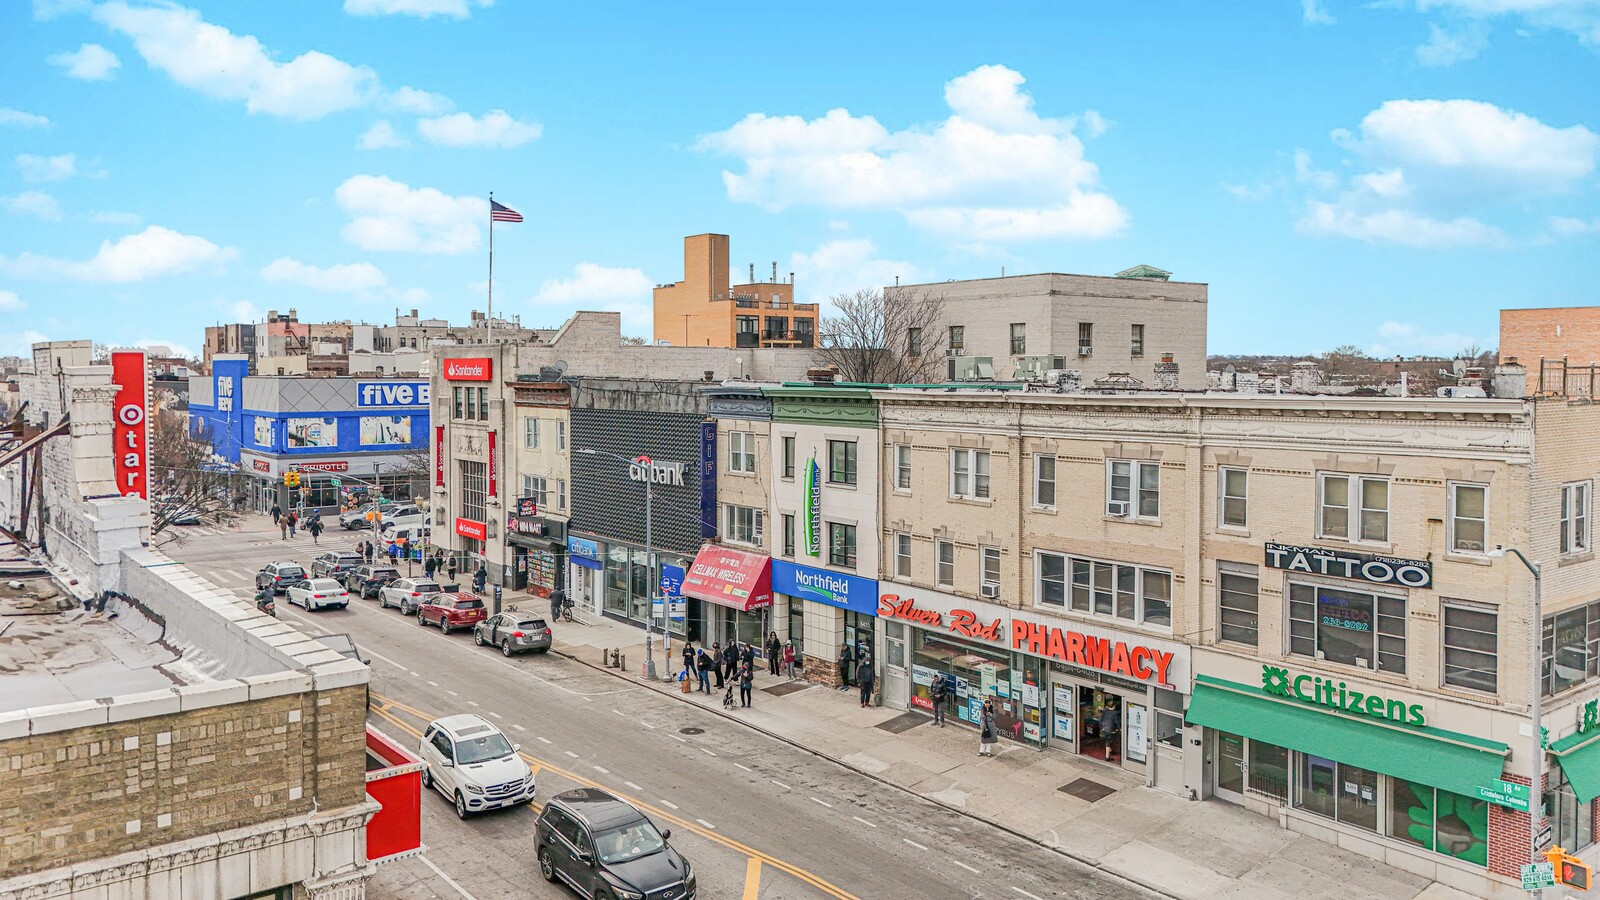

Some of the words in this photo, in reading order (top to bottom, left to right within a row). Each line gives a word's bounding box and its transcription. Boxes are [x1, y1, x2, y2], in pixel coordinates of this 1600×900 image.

[455, 364, 483, 376] Santander
[362, 384, 413, 405] five
[630, 457, 684, 487] citbank
[529, 522, 542, 535] MART
[811, 487, 820, 553] Northfield
[463, 525, 481, 536] Santander
[571, 541, 593, 557] citibank
[1266, 543, 1335, 557] INKMAN
[1266, 549, 1430, 587] TATTOO
[1375, 556, 1430, 569] (718)236-8282
[692, 563, 719, 578] CELLMAX
[717, 568, 746, 585] WIRELESS
[795, 569, 848, 595] Northfield
[832, 593, 848, 605] Bank
[876, 593, 942, 627] Silver
[949, 609, 1001, 641] Rod
[1012, 618, 1174, 685] PHARMACY
[1293, 674, 1425, 726] Citizens
[1025, 727, 1038, 736] FedEx
[1503, 783, 1512, 794] 18
